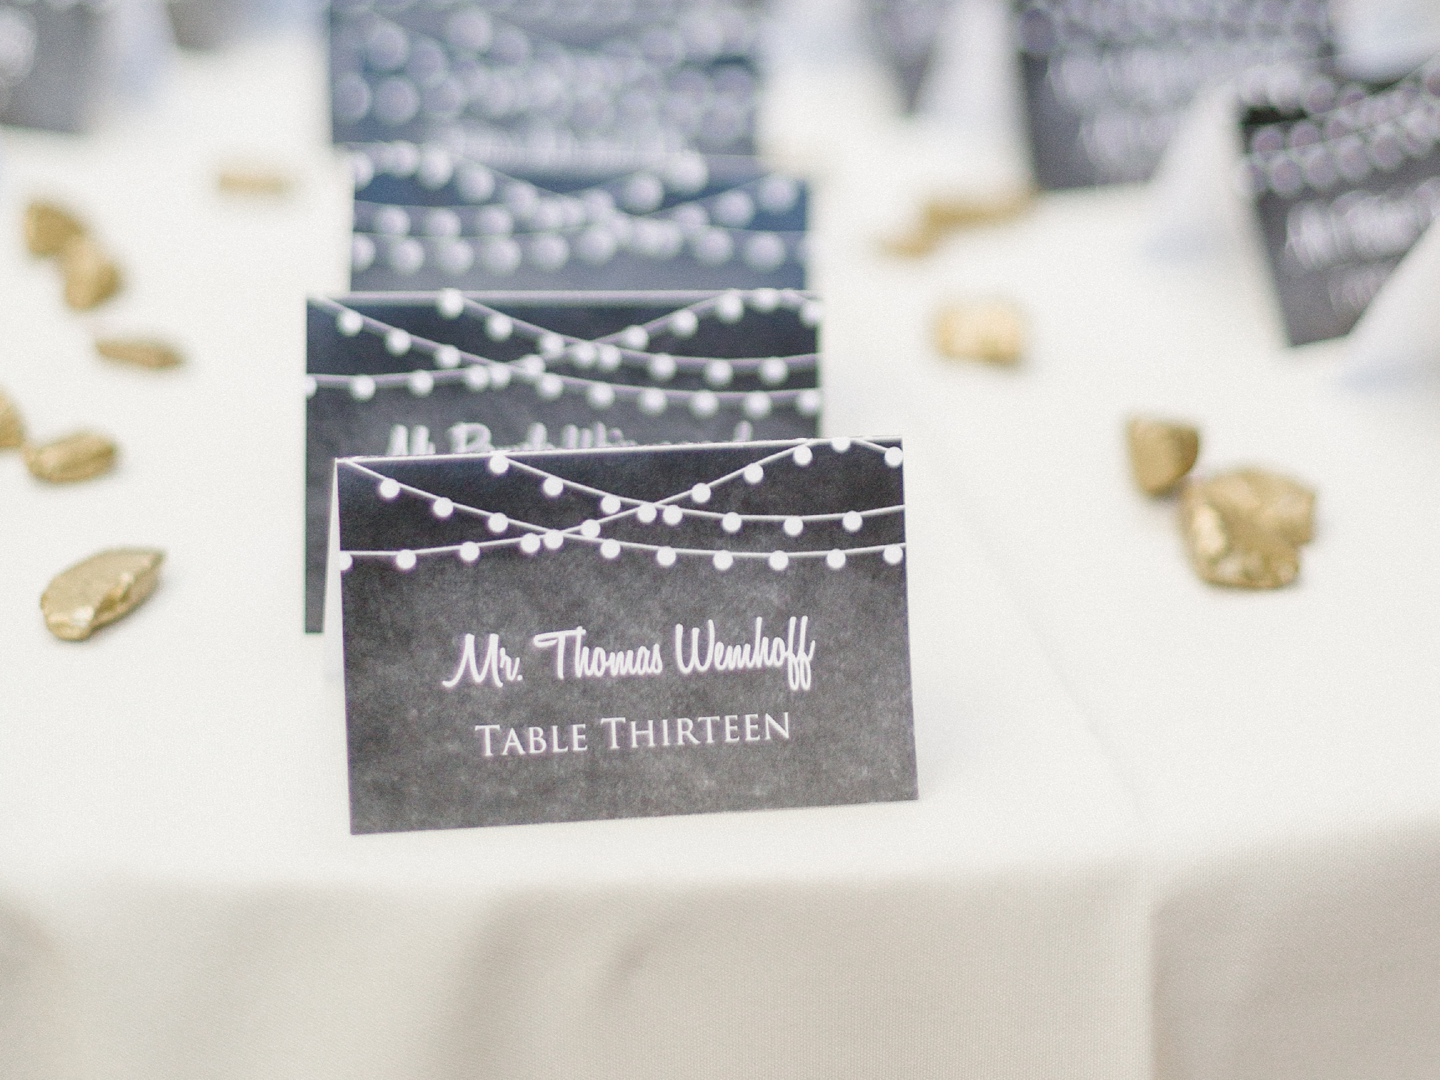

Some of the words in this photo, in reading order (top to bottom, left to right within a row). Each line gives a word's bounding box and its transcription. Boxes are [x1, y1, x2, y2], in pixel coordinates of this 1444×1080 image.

[442, 633, 523, 688] Mr.
[533, 626, 662, 680] Thomas
[675, 616, 815, 690] Wemhoff
[475, 724, 588, 757] TABLE
[600, 712, 790, 749] THIRTEEN
